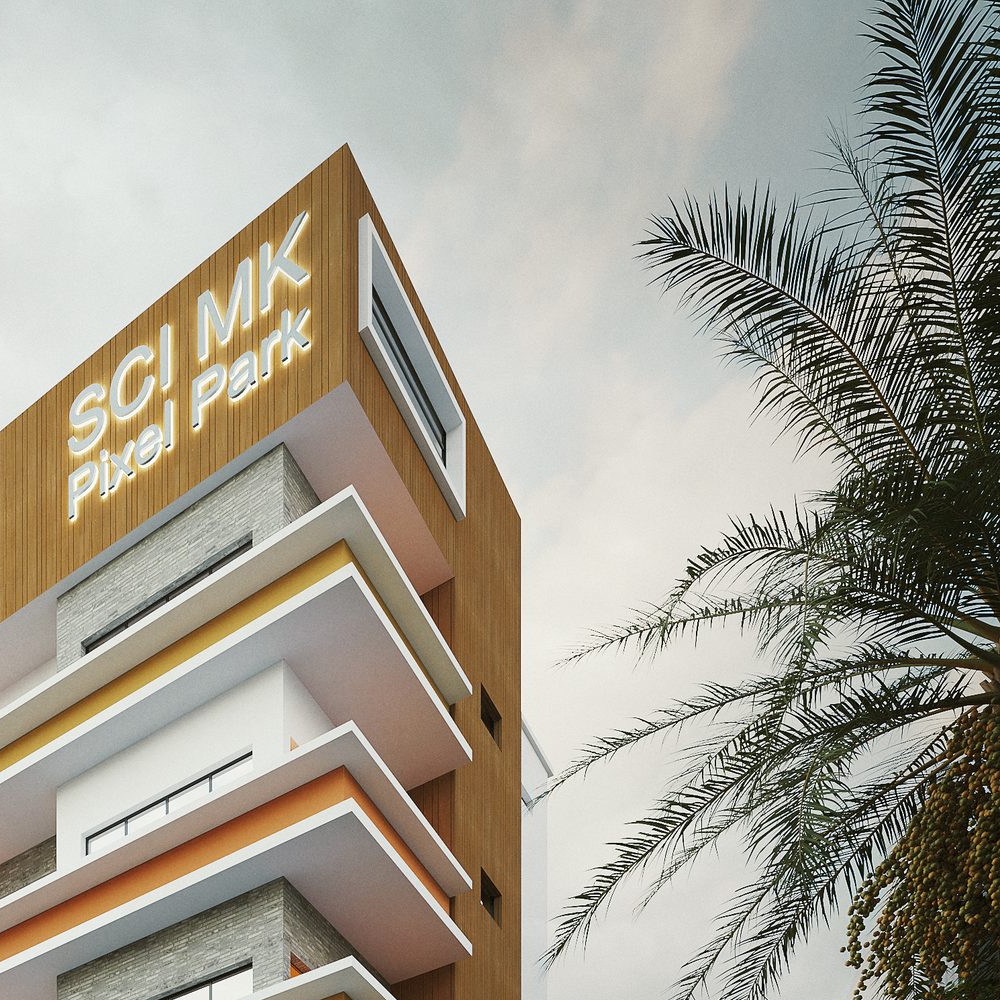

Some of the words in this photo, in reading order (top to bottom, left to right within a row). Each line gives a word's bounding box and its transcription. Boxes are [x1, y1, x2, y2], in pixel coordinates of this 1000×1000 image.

[68, 323, 171, 455] SCI
[198, 210, 310, 362] MK
[68, 399, 173, 521] Pixel
[192, 306, 311, 431] Park
